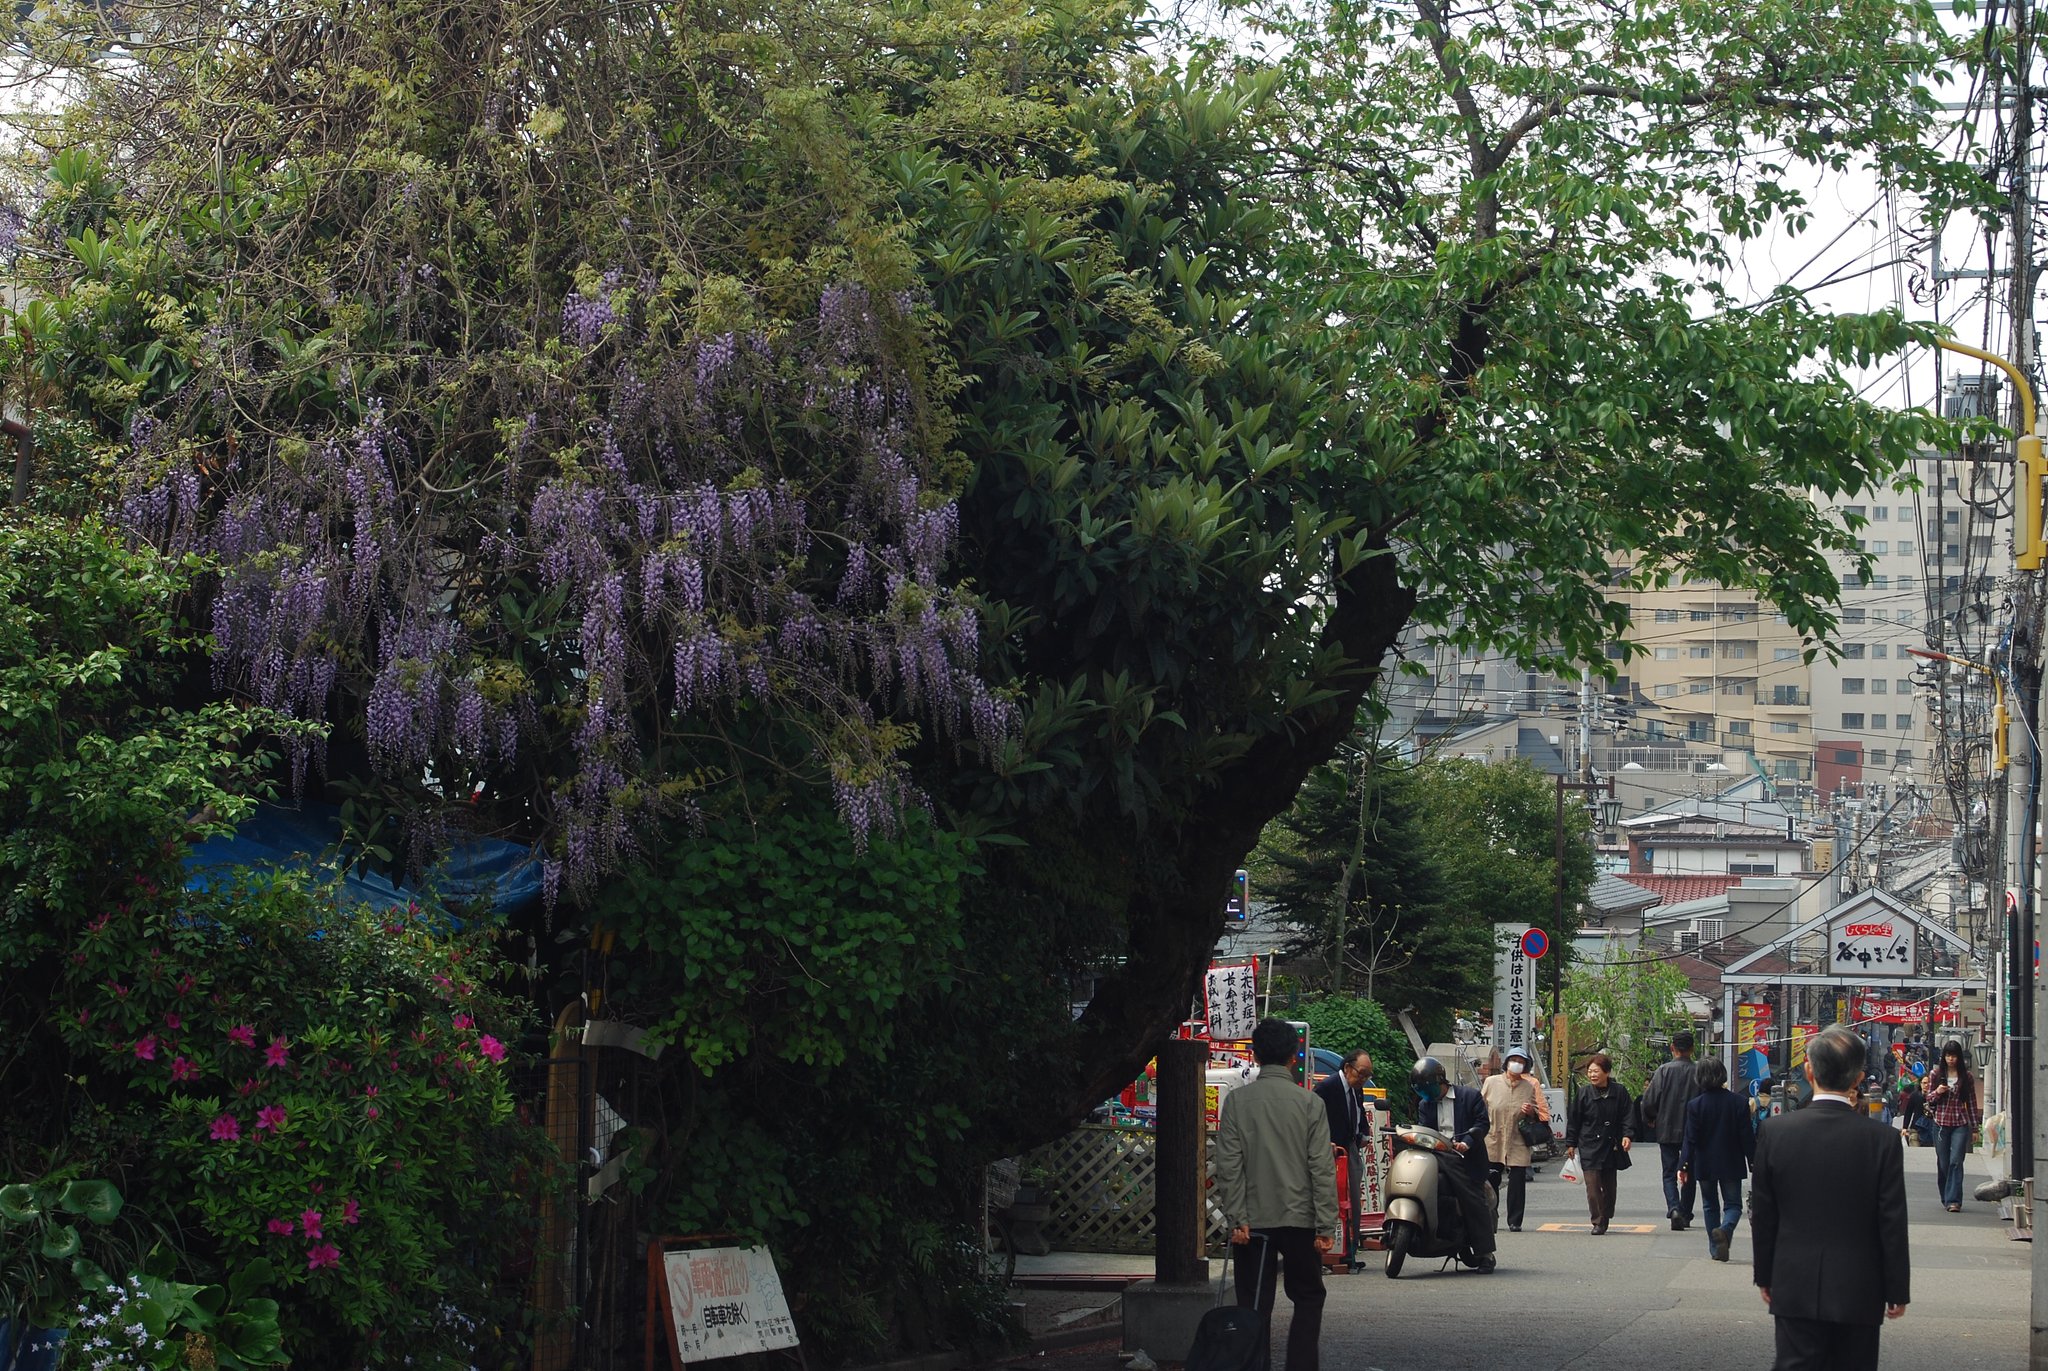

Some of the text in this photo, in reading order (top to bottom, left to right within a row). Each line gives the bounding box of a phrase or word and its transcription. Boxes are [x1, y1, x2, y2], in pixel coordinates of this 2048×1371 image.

[1836, 934, 1909, 969] 谷中ぎんざ
